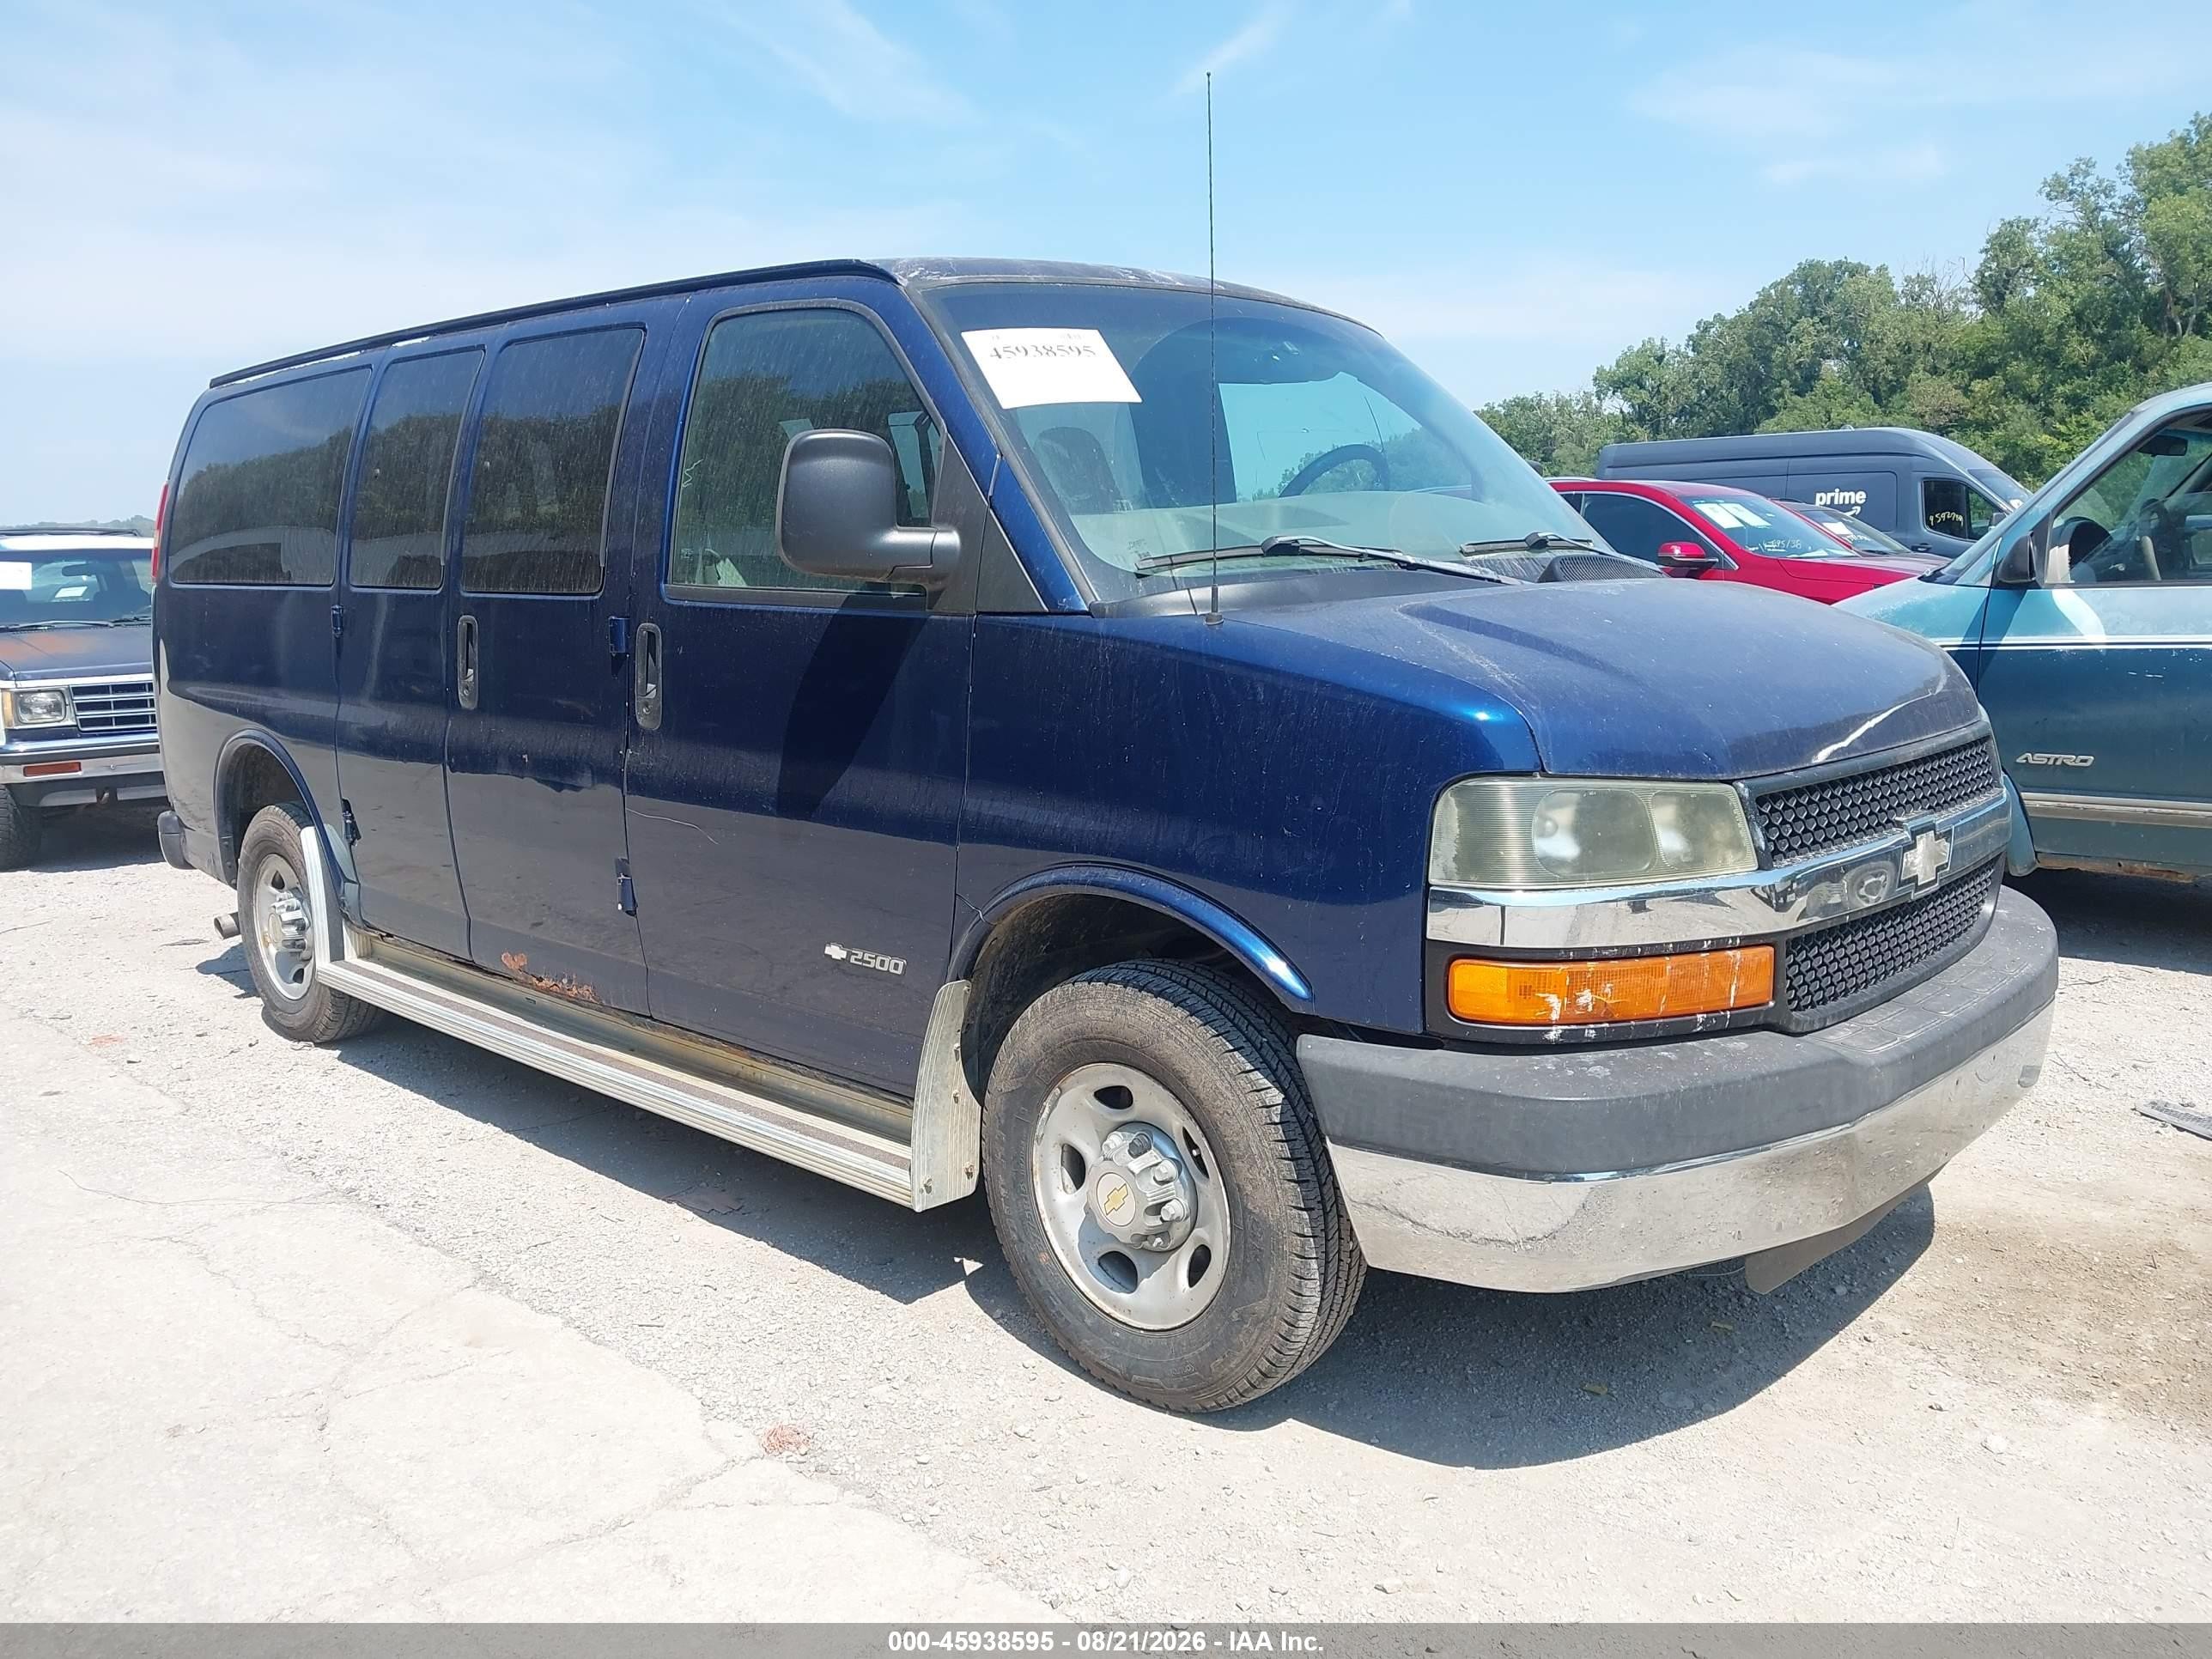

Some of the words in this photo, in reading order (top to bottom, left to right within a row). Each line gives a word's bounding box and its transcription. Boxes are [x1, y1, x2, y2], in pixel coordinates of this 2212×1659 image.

[990, 344, 1097, 360] 45938595
[1815, 488, 1867, 506] prime
[2016, 752, 2095, 767] ASTRO
[849, 948, 907, 975] 2500
